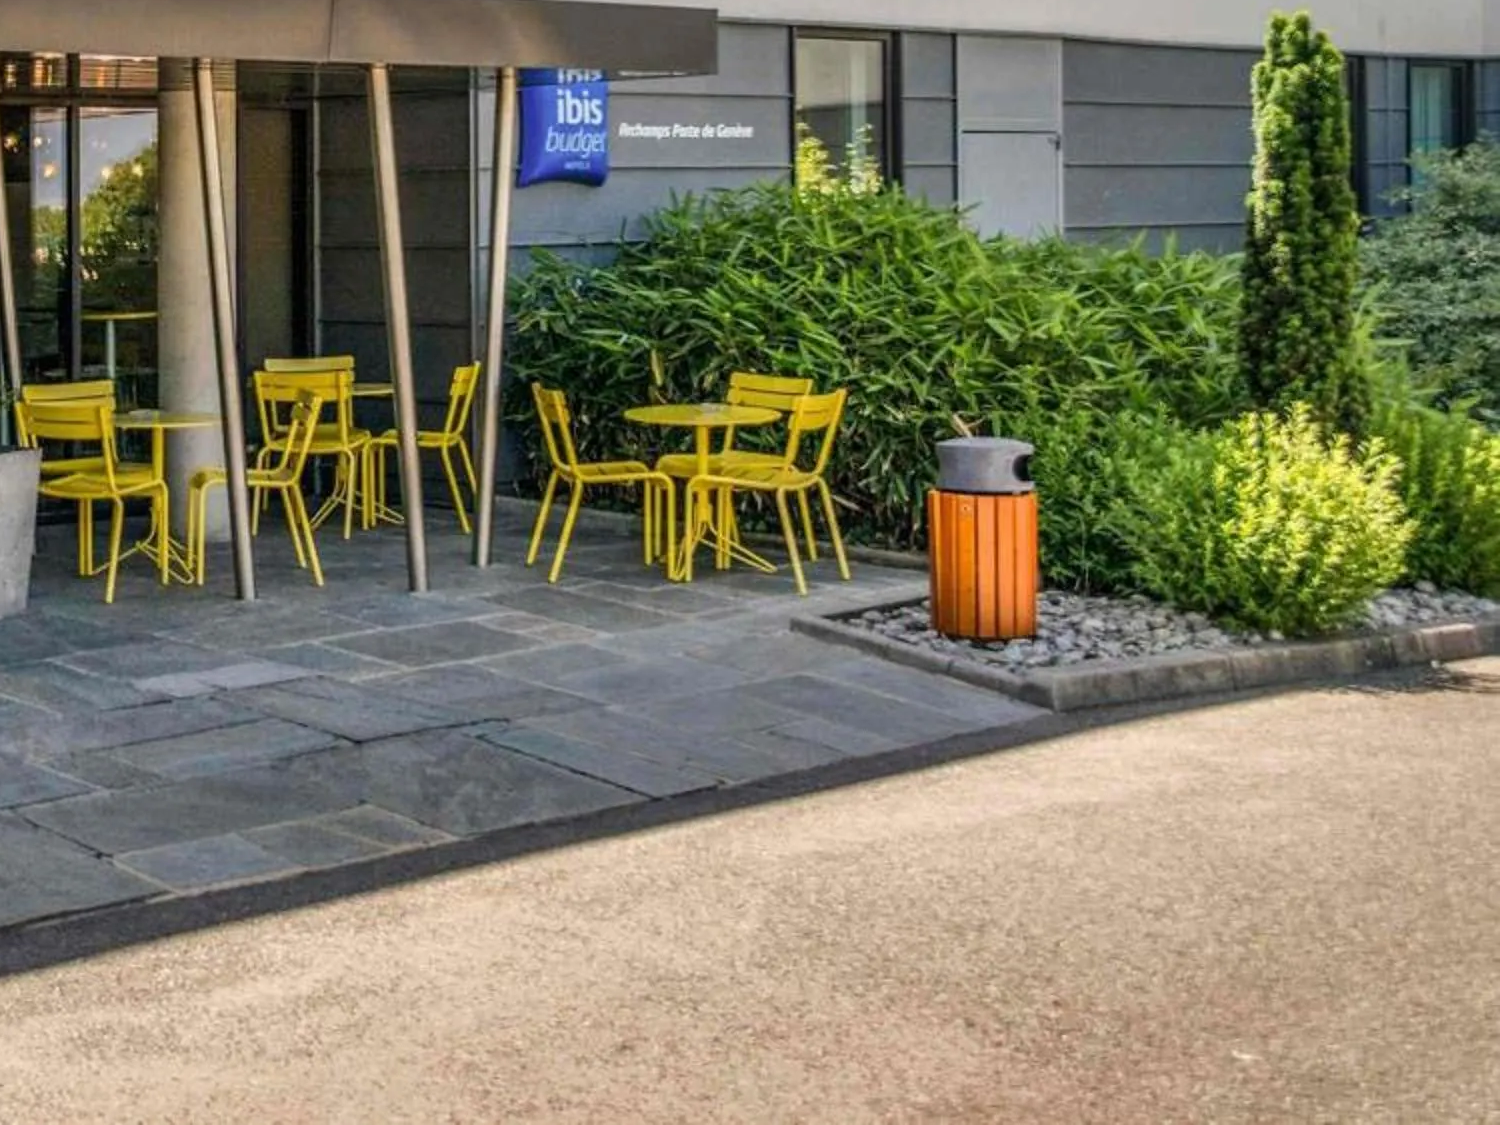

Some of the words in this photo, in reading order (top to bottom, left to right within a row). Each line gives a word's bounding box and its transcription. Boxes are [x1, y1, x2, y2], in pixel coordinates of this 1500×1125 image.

[556, 88, 603, 125] ibis
[545, 126, 607, 158] budget
[701, 124, 714, 138] de
